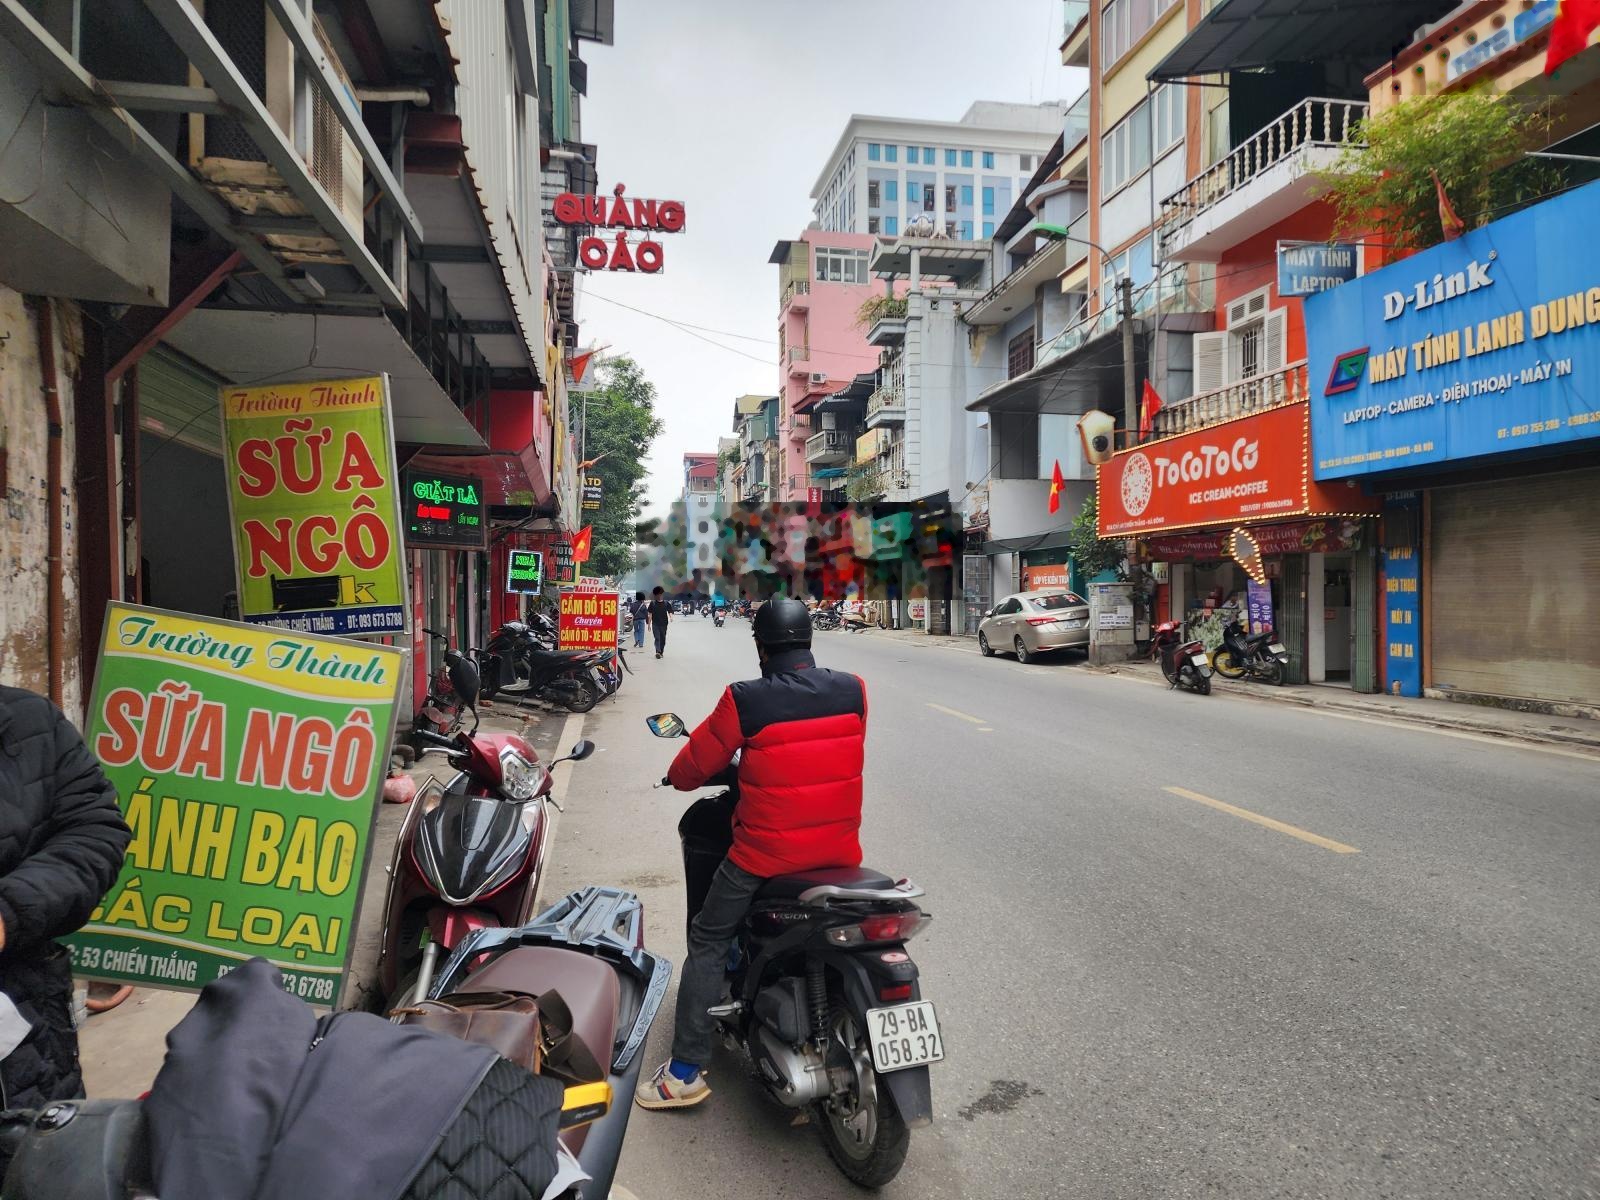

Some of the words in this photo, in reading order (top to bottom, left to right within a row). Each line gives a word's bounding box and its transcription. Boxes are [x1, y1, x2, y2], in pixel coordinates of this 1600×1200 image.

[553, 182, 685, 233] QUẢNG
[580, 231, 663, 273] CÁO
[1320, 247, 1351, 267] TÍNH
[1383, 260, 1494, 321] D-Link
[1369, 346, 1408, 384] MÁY
[1412, 332, 1460, 371] TÍNH
[1464, 310, 1525, 357] LANH
[1530, 287, 1600, 339] DUNG
[231, 391, 302, 413] Trường
[310, 383, 376, 408] Thành
[1343, 408, 1382, 425] LAPTOP
[1388, 393, 1434, 416] CAMERA
[1442, 381, 1471, 404] ĐIỆN
[1471, 373, 1513, 395] THOẠI
[1520, 360, 1552, 385] MÁY
[1555, 358, 1573, 377] IN
[236, 417, 385, 498] SỮA
[413, 480, 454, 504] GIẶT
[457, 485, 478, 505] LÀ
[1189, 492, 1202, 505] ICE
[241, 493, 391, 579] NGÔ
[312, 613, 335, 632] THẮNG
[347, 615, 358, 629] ĐT:
[359, 613, 371, 628] 093
[372, 612, 384, 627] 673
[385, 611, 403, 627] 6788
[118, 616, 254, 669] Trường
[265, 639, 387, 686] Thành
[96, 678, 227, 781] SỮA
[235, 707, 377, 801] NGÔ
[126, 778, 238, 880] ÁNH
[241, 810, 358, 897] BAO
[205, 901, 343, 959] LOẠI
[81, 946, 101, 969] 53
[102, 946, 148, 975] CHIẾN
[149, 950, 198, 982] THẮNG
[297, 975, 334, 1000] 6788
[877, 1007, 928, 1038] 29-BA
[877, 1033, 940, 1067] 058.32
